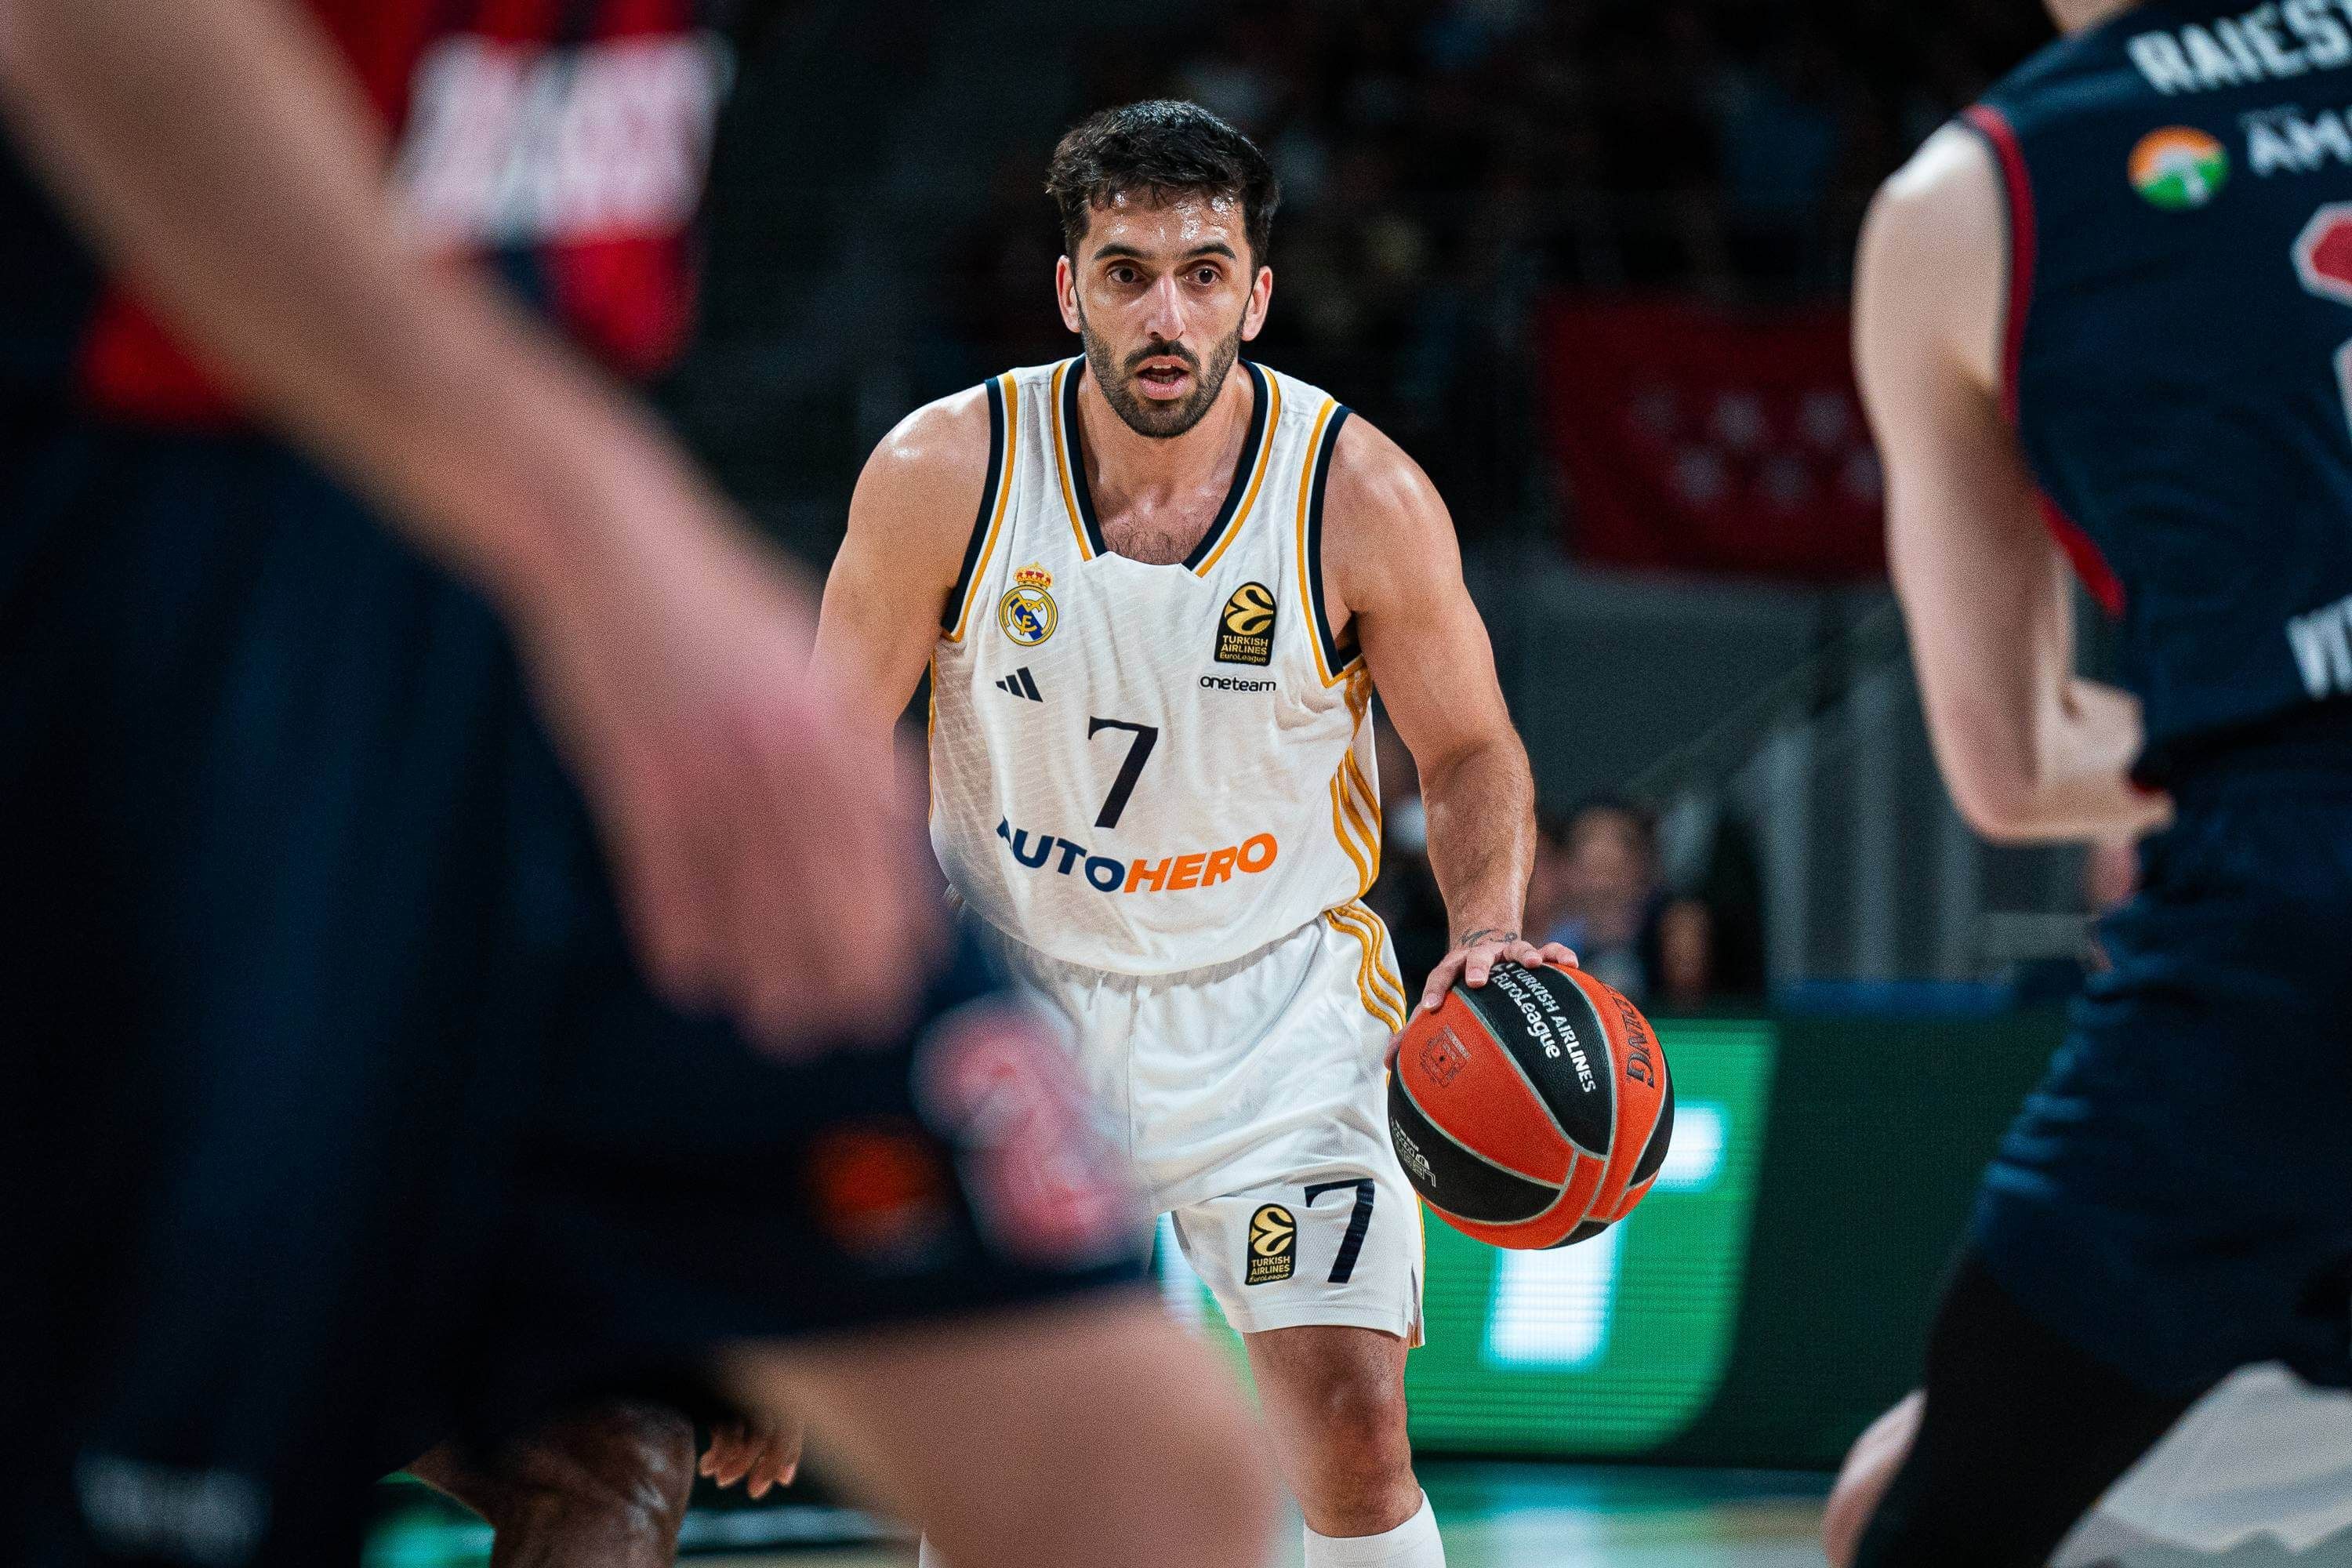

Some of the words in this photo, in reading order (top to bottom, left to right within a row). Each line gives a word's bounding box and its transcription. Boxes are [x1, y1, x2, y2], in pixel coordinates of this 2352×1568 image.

[2126, 0, 2352, 96] RAIES
[1221, 644, 1268, 655] AIRLINES
[1223, 635, 1269, 647] TURKISH
[1200, 676, 1276, 691] oneteam
[1087, 716, 1159, 829] 7
[1491, 972, 1561, 1059] EuroLeague
[1512, 967, 1560, 1013] TURKISH
[1551, 1014, 1596, 1093] AIRLINES
[1304, 1178, 1375, 1284] 7
[1250, 1255, 1290, 1268] TURKISH
[1251, 1265, 1290, 1276] AIRLINES
